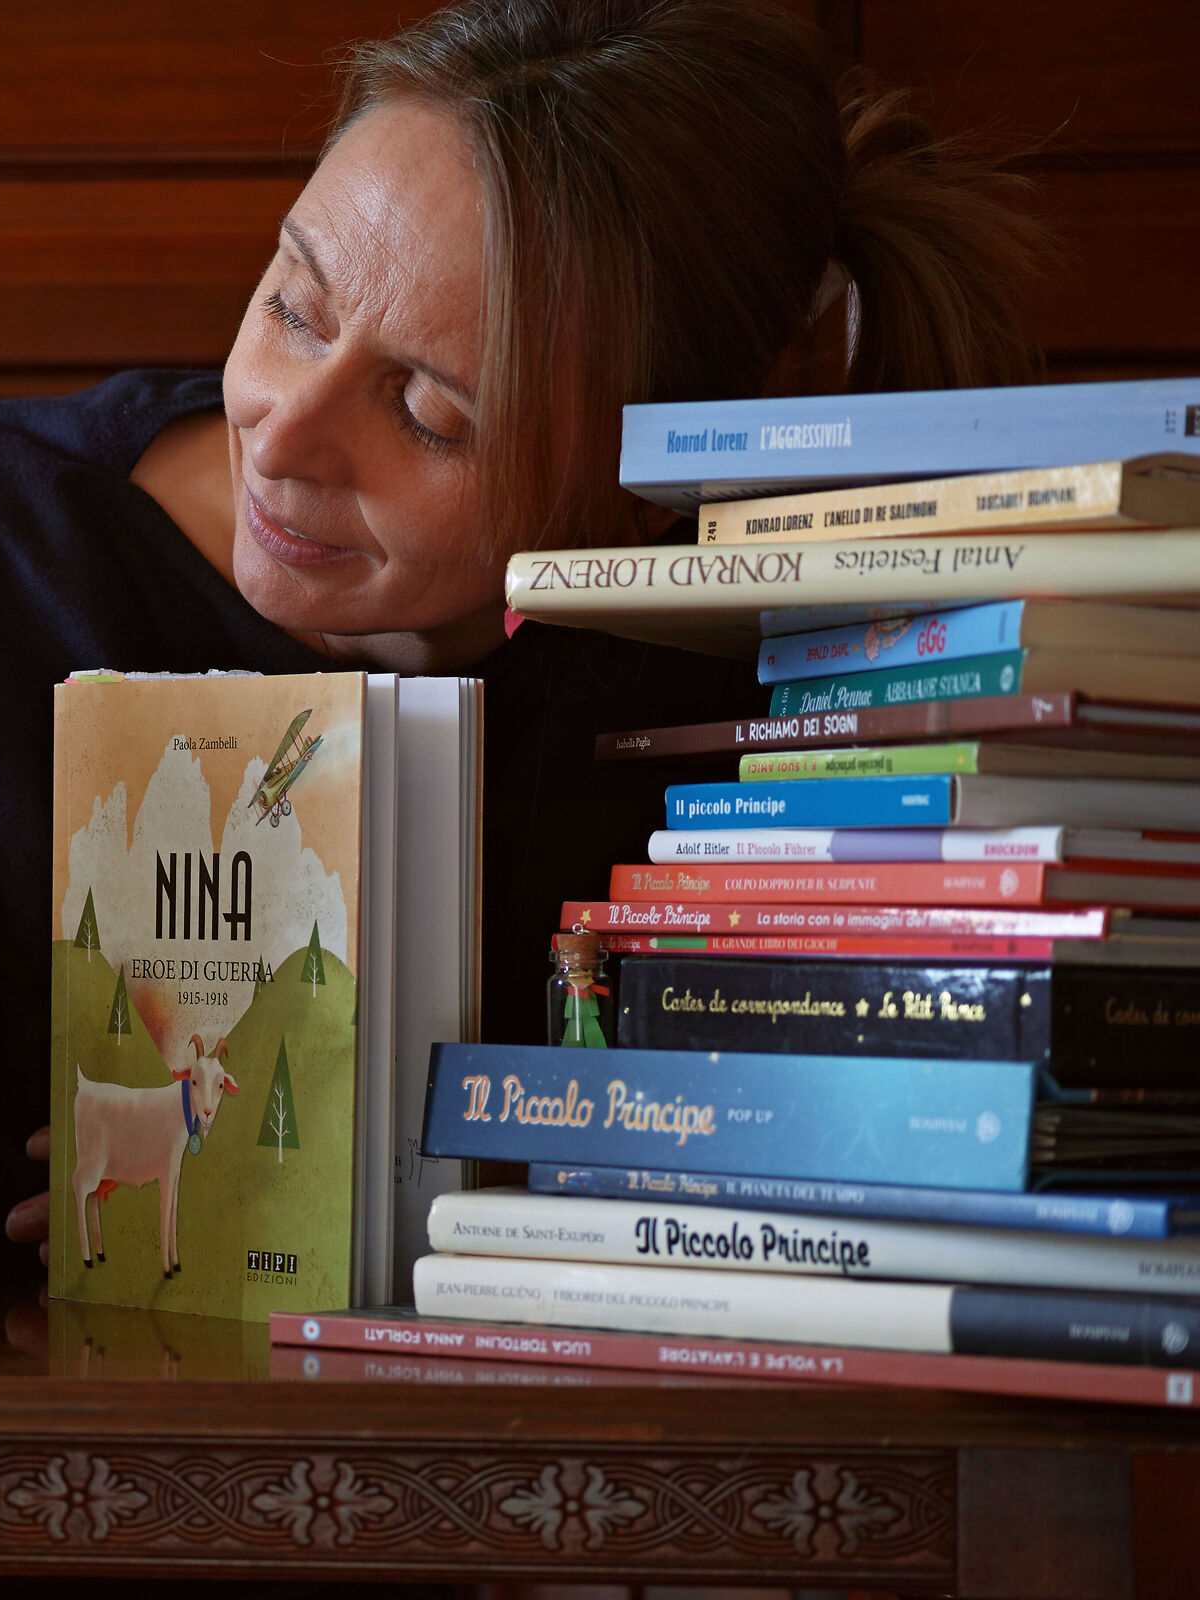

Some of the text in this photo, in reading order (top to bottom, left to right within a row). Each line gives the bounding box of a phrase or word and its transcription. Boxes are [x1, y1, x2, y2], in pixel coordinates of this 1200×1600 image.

[667, 417, 851, 453] Konrad Lorenz L'AGGRESSIVITÀ
[745, 500, 938, 535] KONRAD LORENZ L'ANELLO DI RE SALOMONE
[707, 521, 717, 541] 248
[529, 552, 804, 590] KONRAD LORENZ
[834, 545, 1025, 576] Antal Festetics
[799, 683, 835, 714] Daniel
[735, 714, 858, 743] IL RICHIAMO DEI SOGNI
[173, 736, 237, 750] Paola Zambelli
[748, 763, 774, 774] AMICI
[676, 796, 786, 819] Il piccolo Principe
[675, 842, 817, 855] Adolf Hitler Il Piccolo Führer
[155, 849, 253, 941] NINA
[644, 872, 674, 890] Piccolo
[677, 872, 711, 895] Principe
[725, 878, 757, 891] COLPO
[758, 878, 794, 891] DOPPIO
[795, 878, 815, 891] PER
[608, 905, 619, 924] Il
[621, 905, 662, 924] Piccolo
[664, 905, 711, 932] Principe
[757, 912, 770, 925] La
[773, 912, 805, 926] storia
[808, 914, 830, 926] con
[833, 913, 845, 926] le
[847, 913, 904, 930] immagini
[722, 937, 756, 949] GRANDE
[759, 938, 786, 950] LIBRO
[131, 959, 275, 982] EROE DI GUERRA
[178, 991, 228, 1005] 1915-1918
[662, 987, 846, 1024] Cartes de correspondance
[462, 1075, 774, 1146] Il Piccolo Principe POP UP
[635, 1216, 872, 1277] Il Piccolo Principe
[247, 1250, 297, 1274] TIPI
[247, 1272, 297, 1286] EDIZIONI
[364, 1328, 592, 1356] LUCA TORTOLINI ANNA FORLATI
[750, 1352, 761, 1368] E
[765, 1353, 818, 1372] VOLPE
[821, 1357, 845, 1373] LA
